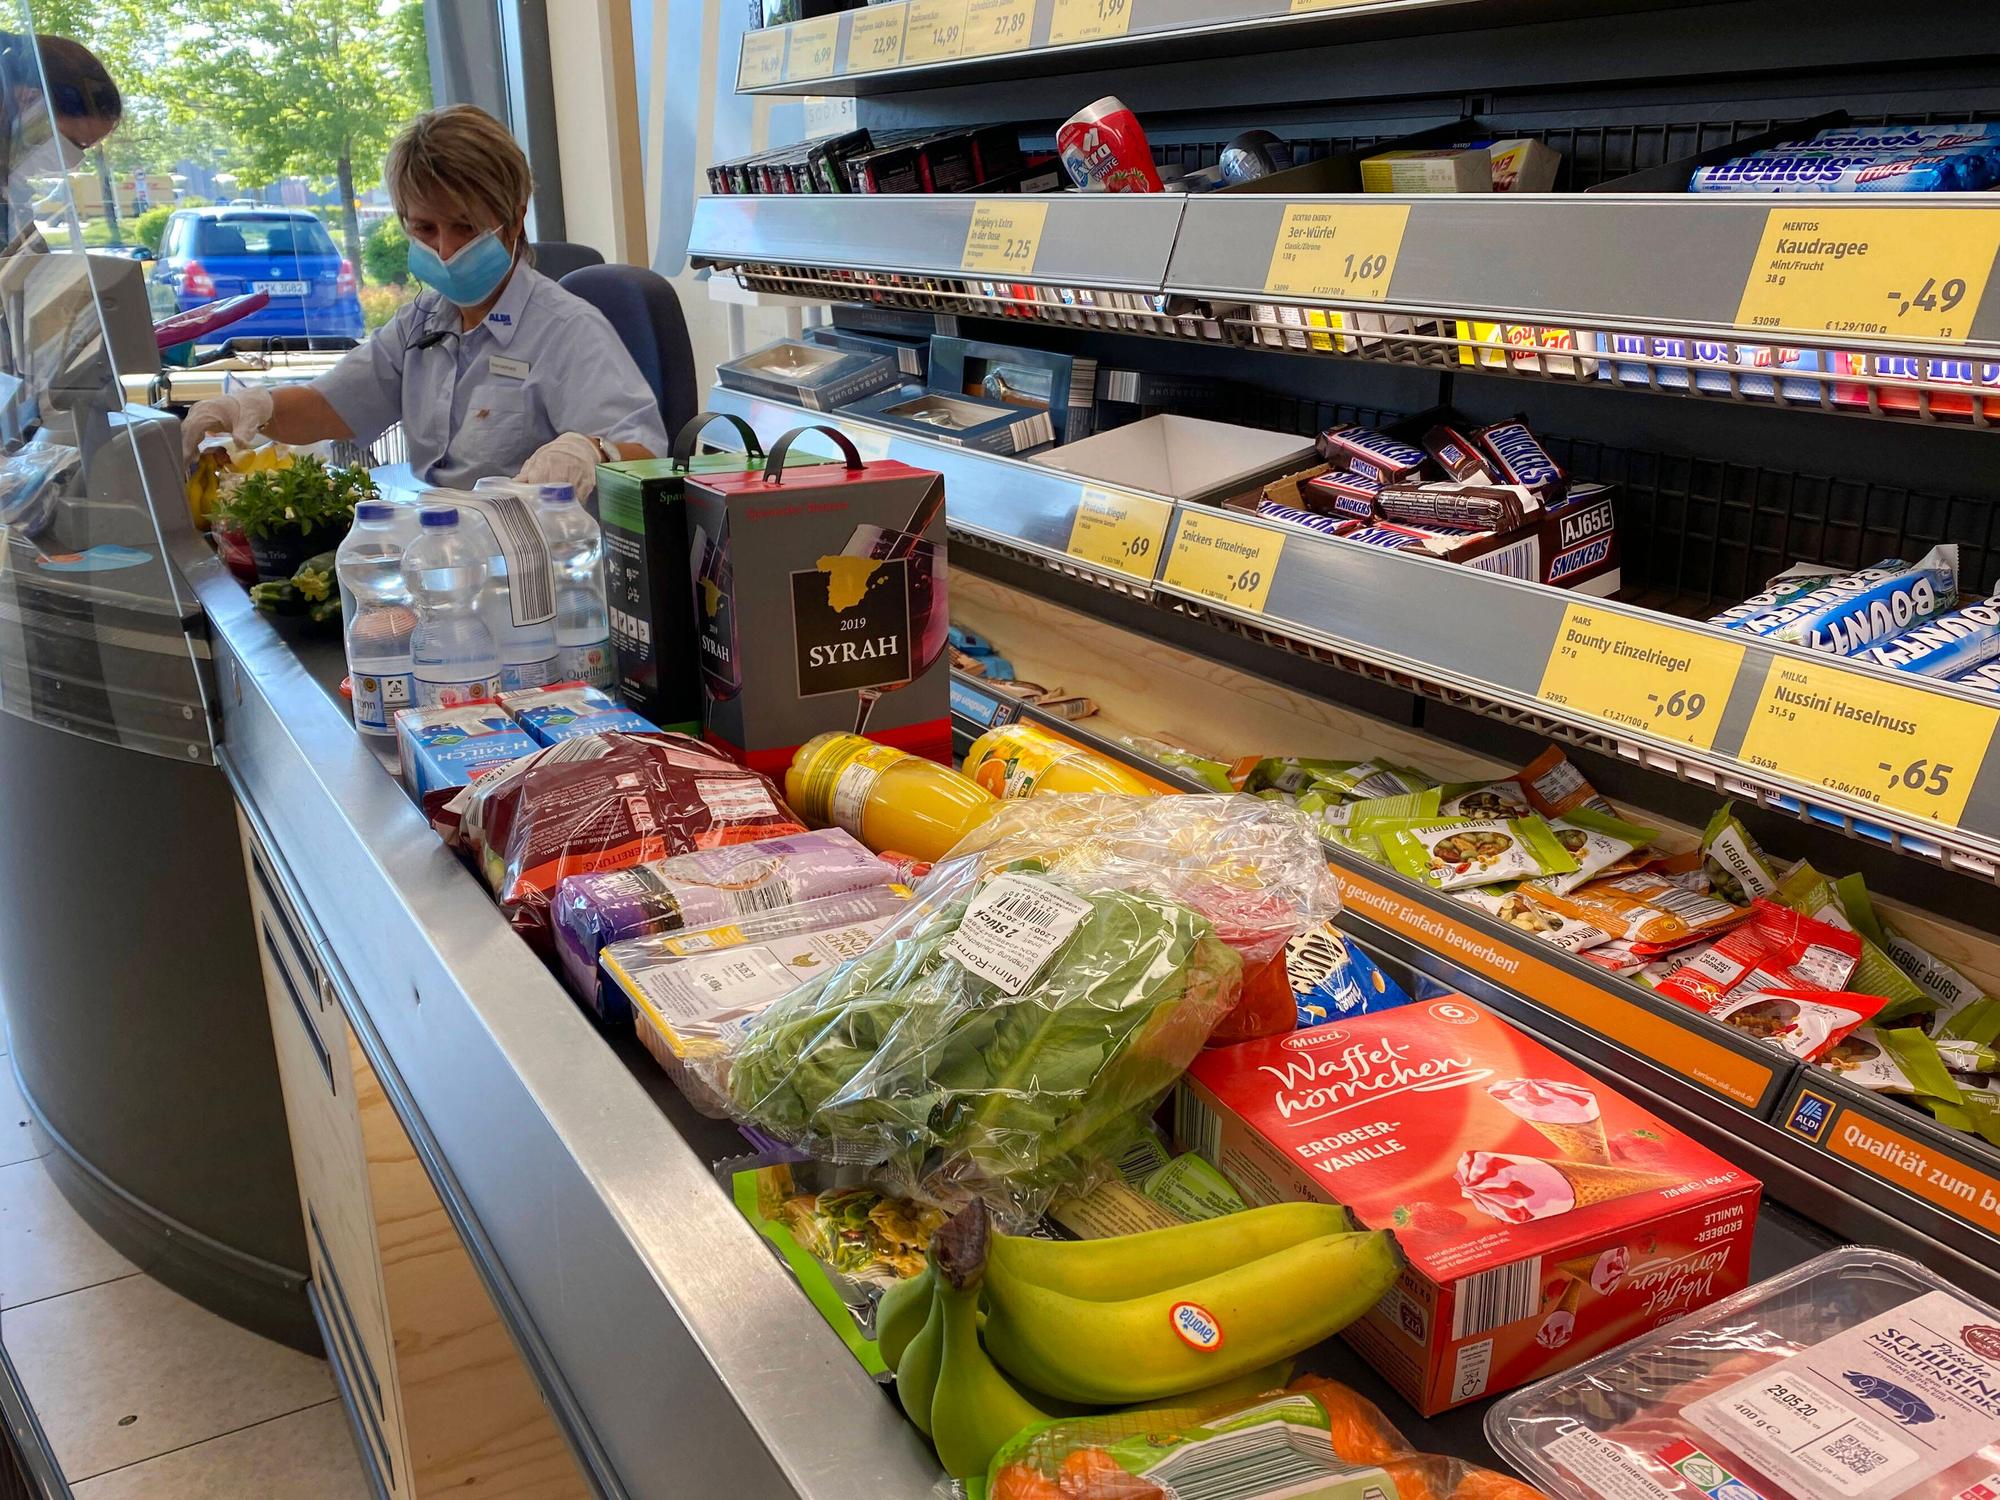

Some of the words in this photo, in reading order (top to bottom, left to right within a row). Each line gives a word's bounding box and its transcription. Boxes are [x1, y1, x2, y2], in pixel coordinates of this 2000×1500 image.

[932, 26, 959, 46] 14,99
[994, 13, 1025, 36] 27,89
[872, 36, 898, 54] 22,99
[1094, 157, 1120, 182] WHITE
[999, 219, 1013, 229] Extra
[1288, 226, 1336, 239] 3er-Würfel
[1783, 222, 1820, 232] MENTOS
[1004, 239, 1031, 260] 2,25
[1776, 238, 1869, 260] Kaudragee
[1344, 254, 1387, 283] 1,69
[1770, 260, 1825, 272] Mint/Frucht
[1765, 274, 1778, 284] 38
[1779, 276, 1786, 286] g
[1887, 278, 1967, 318] -,49
[489, 313, 511, 322] ALDI
[1752, 316, 1780, 327] 53098
[1826, 321, 1833, 331] €
[1834, 321, 1873, 334] 1,29/100
[1939, 328, 1952, 338] 13
[1490, 425, 1558, 487] SNICKERS
[1351, 458, 1379, 480] SNICKERS
[1106, 505, 1128, 520] Riegel
[1337, 496, 1371, 517] SNICKERS
[1186, 519, 1198, 528] MARS
[1564, 502, 1613, 545] AJ65E
[1122, 536, 1150, 558] -,69
[1182, 530, 1213, 547] Snickers
[1215, 537, 1260, 560] Einzelriegel
[1549, 537, 1611, 581] SNICKERS
[1227, 569, 1261, 593] -,69
[840, 617, 867, 631] 2019
[1572, 615, 1592, 627] MARS
[702, 634, 729, 663] SYRAH
[809, 635, 899, 669] SYRAH
[1561, 646, 1570, 656] 57
[1570, 650, 1577, 658] g
[1566, 629, 1612, 655] Bounty
[1613, 641, 1692, 673] Einzelriegel
[1781, 670, 1808, 685] MILKA
[963, 695, 993, 718] Pfandbon
[1647, 689, 1706, 721] -,69
[1768, 705, 1788, 718] 31,5
[1788, 711, 1796, 722] g
[1774, 686, 1833, 713] Nussini
[1833, 701, 1918, 736] Haselnuss
[1545, 691, 1568, 704] 52952
[1603, 709, 1608, 717] €
[1609, 710, 1642, 727] 1,21/100
[1688, 734, 1694, 743] 4
[437, 740, 528, 763] H-MILCH
[1750, 755, 1778, 770] 53638
[1822, 777, 1829, 786] €
[1829, 778, 1872, 800] 2,06/100
[1931, 811, 1938, 820] 4
[1878, 759, 1954, 796] -,65
[1419, 821, 1460, 836] VEGGIE
[1720, 839, 1753, 880] VEGGIE
[973, 909, 1008, 934] Stück
[1347, 884, 1399, 916] gesucht?
[1398, 907, 1444, 939] Einfach
[1446, 928, 1520, 975] bewerben!
[1577, 925, 1604, 944] NUTS
[1887, 942, 1925, 978] VEGGIE
[1924, 970, 1963, 1004] BURST
[1438, 1005, 1461, 1019] 6
[1288, 1030, 1343, 1049] Mucci
[1258, 1037, 1410, 1090] Waffel-
[1274, 1055, 1473, 1120] hörnchen
[1795, 1114, 1820, 1131] ALDI
[1296, 1121, 1403, 1160] ERDBEER-
[1312, 1138, 1407, 1174] VANILLE
[1843, 1124, 1928, 1178] Qualität
[1928, 1168, 1977, 1202] zum
[1660, 1187, 1678, 1200] 720
[1704, 1204, 1744, 1226] VANILLE
[1694, 1220, 1743, 1243] ERDBEER-
[1179, 1306, 1217, 1345] favorita
[1931, 1342, 1992, 1379] Frische
[1733, 1402, 1756, 1422] 400
[1767, 1384, 1818, 1418] 29.05.20
[1947, 1395, 1973, 1413] Braten
[1578, 1429, 1601, 1448] ALDI
[1600, 1444, 1620, 1463] SÜD
[1619, 1457, 1669, 1500] unterstützt
